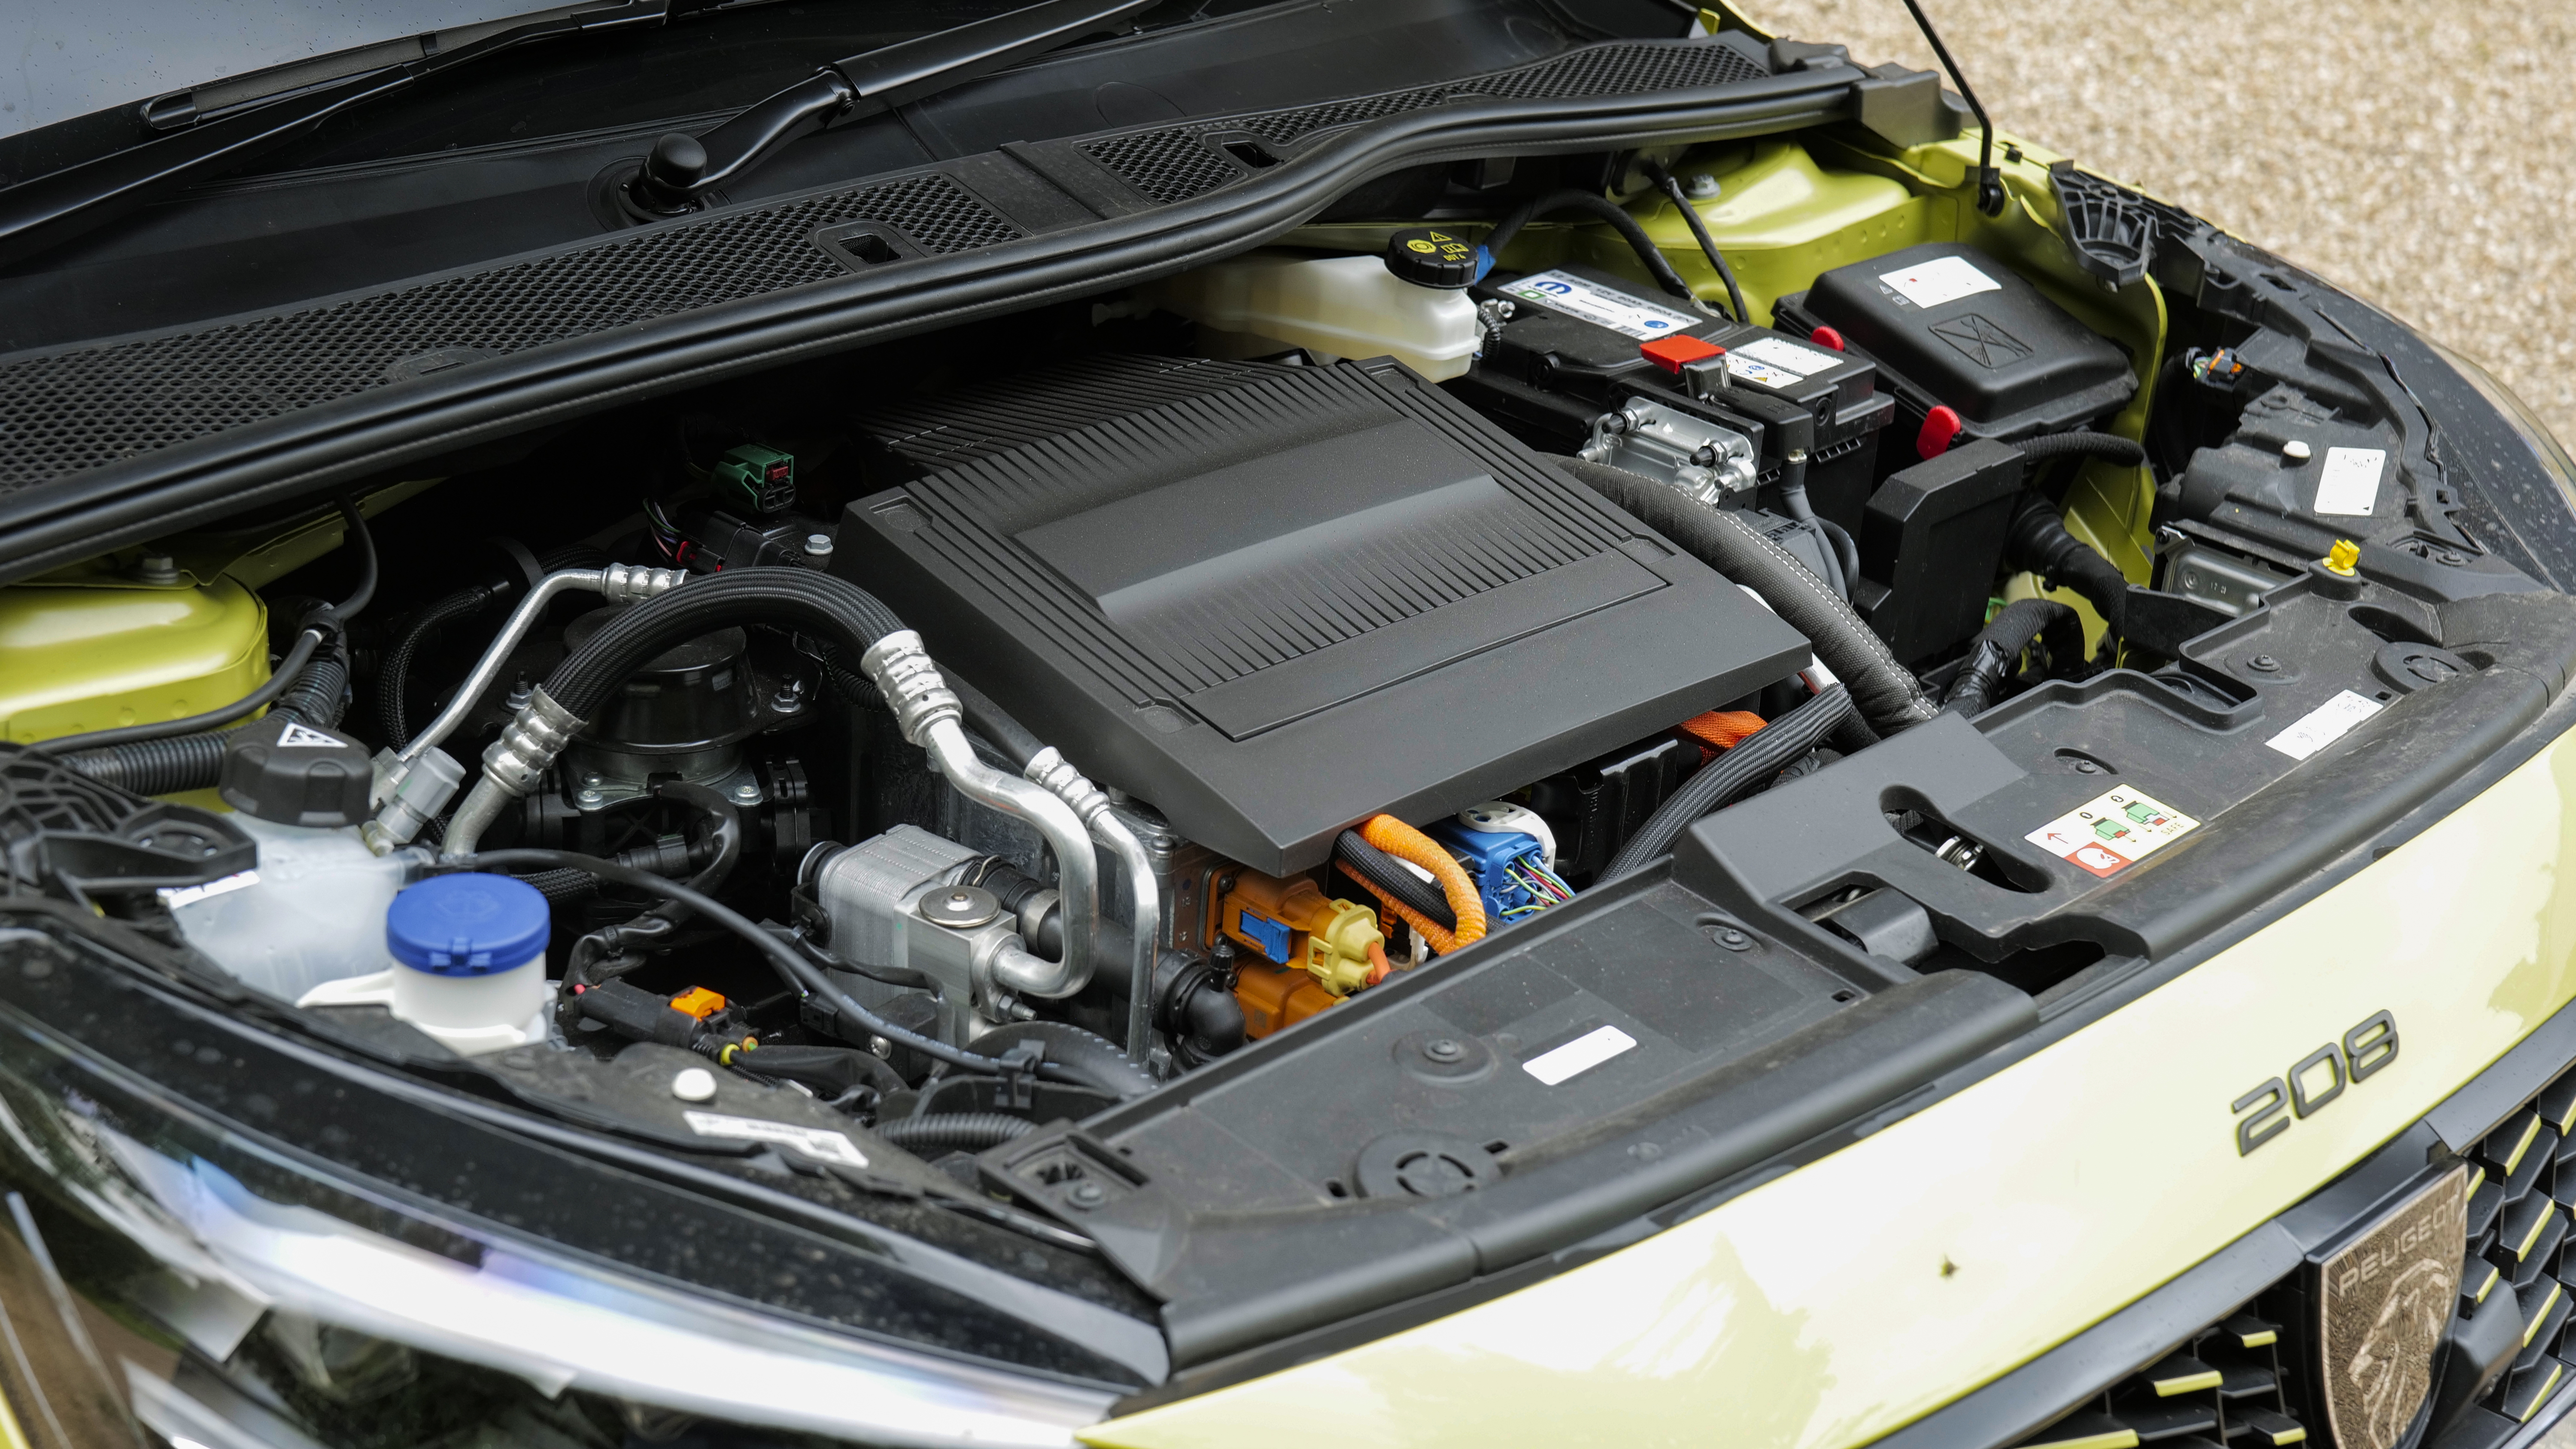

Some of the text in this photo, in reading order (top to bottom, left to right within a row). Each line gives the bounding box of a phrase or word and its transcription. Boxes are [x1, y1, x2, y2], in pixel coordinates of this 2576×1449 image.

[2160, 822, 2184, 835] SAFE
[2231, 1009, 2399, 1157] 208
[2340, 1194, 2458, 1297] PEUGEOT
